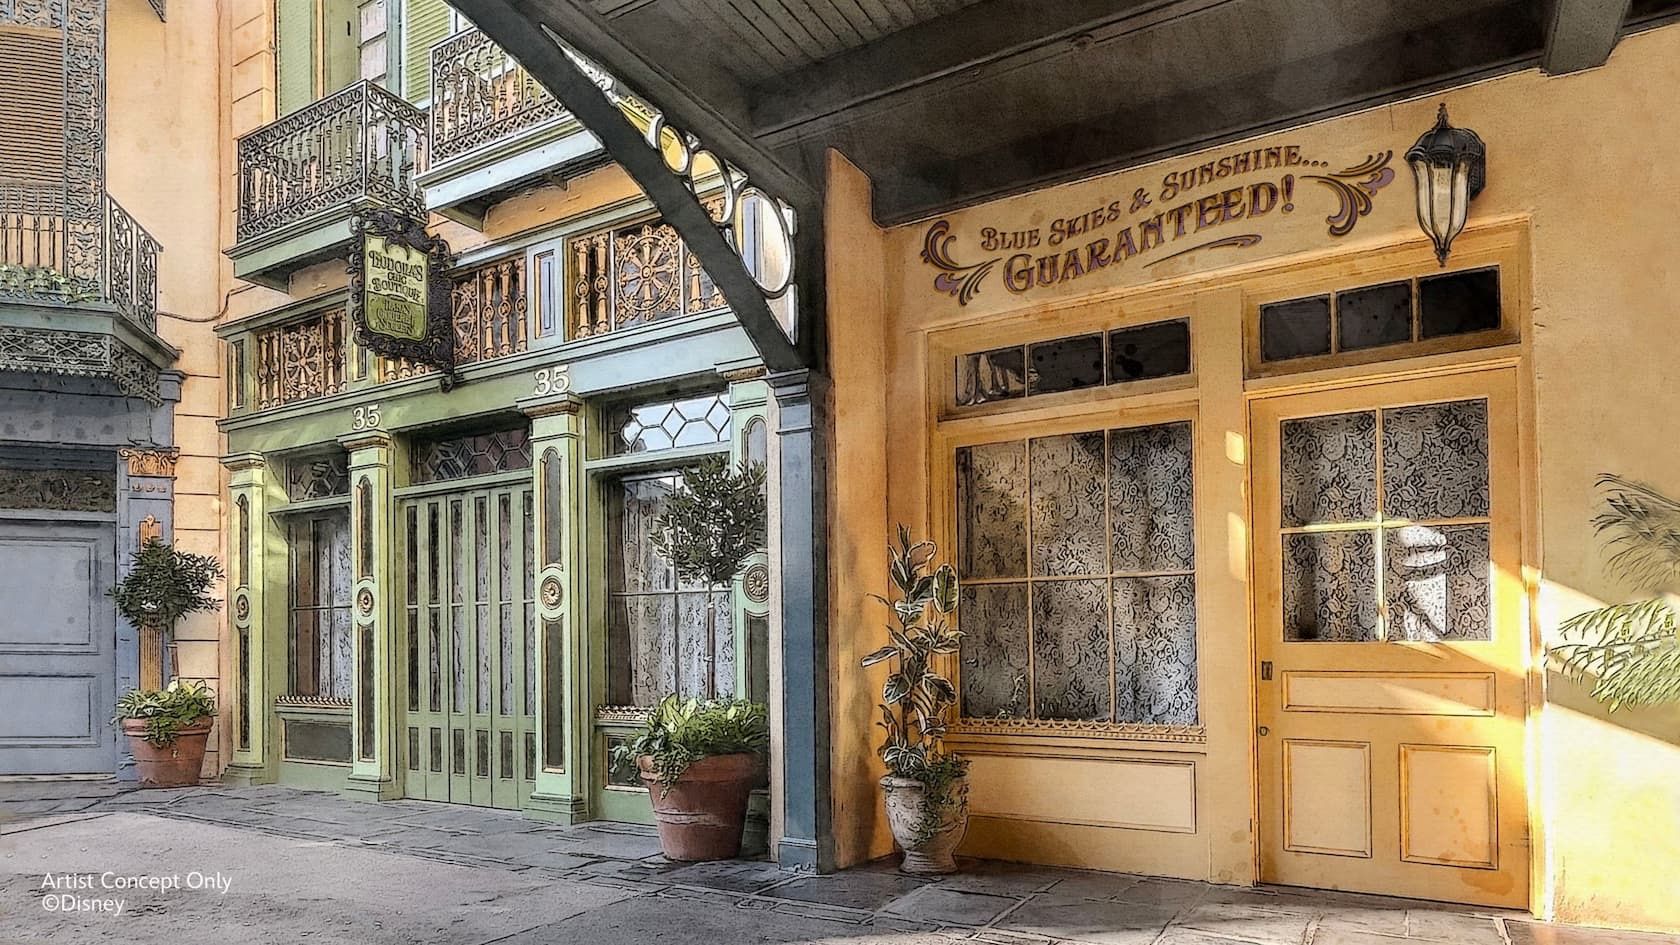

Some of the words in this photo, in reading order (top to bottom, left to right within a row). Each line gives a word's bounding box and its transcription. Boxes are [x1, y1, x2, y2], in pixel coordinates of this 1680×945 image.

[981, 226, 1041, 252] BLUE
[1048, 202, 1120, 246] SKIES
[1129, 188, 1153, 211] &
[1002, 174, 1295, 294] GUARANTEED!
[534, 365, 570, 396] 35
[352, 404, 381, 431] 35
